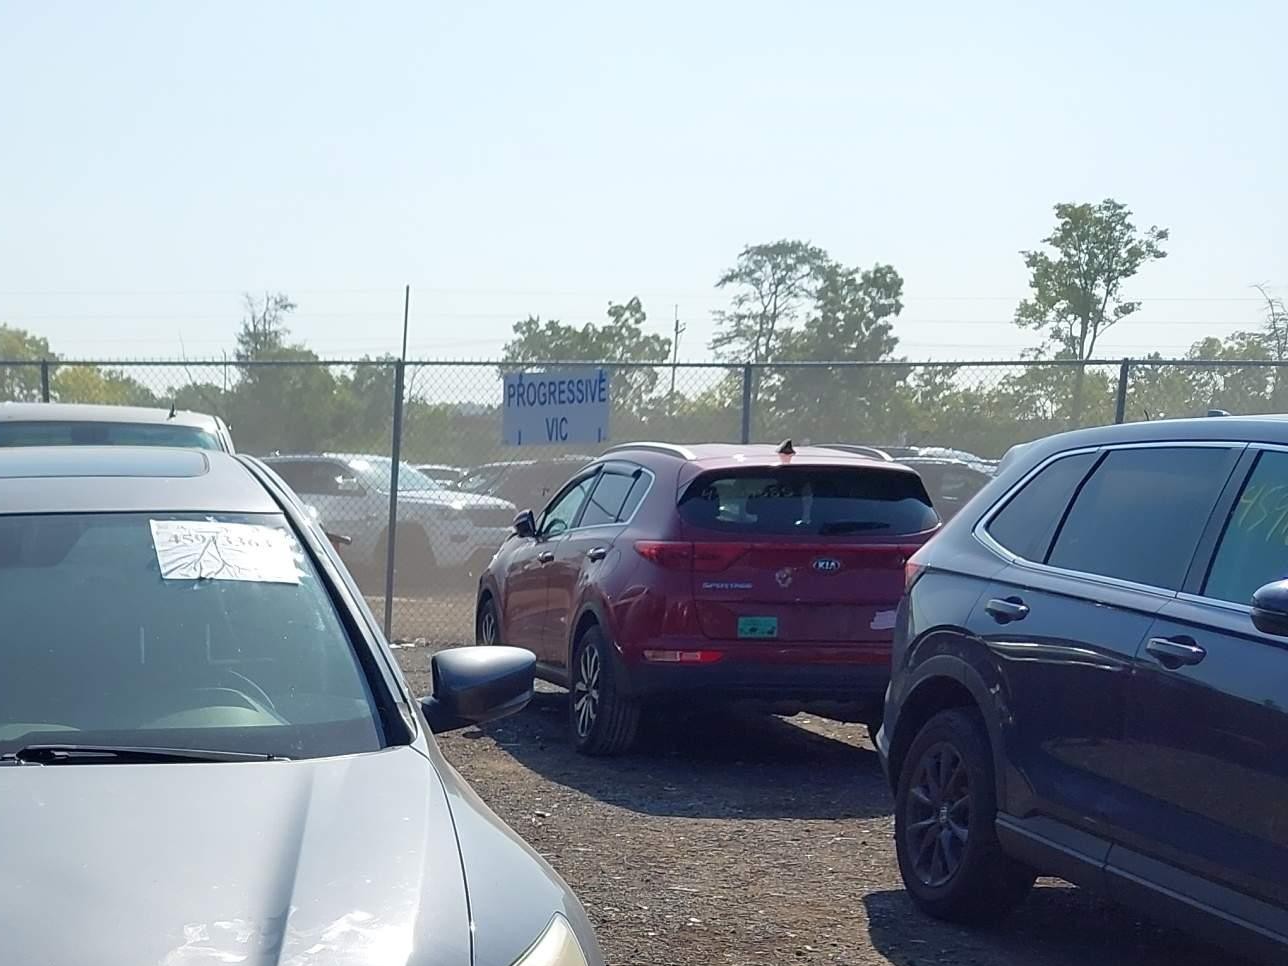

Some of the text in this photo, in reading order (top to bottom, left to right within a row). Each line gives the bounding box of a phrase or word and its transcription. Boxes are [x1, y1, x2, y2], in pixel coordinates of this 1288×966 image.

[507, 378, 607, 408] PROGRESSIVE
[545, 416, 569, 442] VIC
[817, 560, 837, 571] KIA
